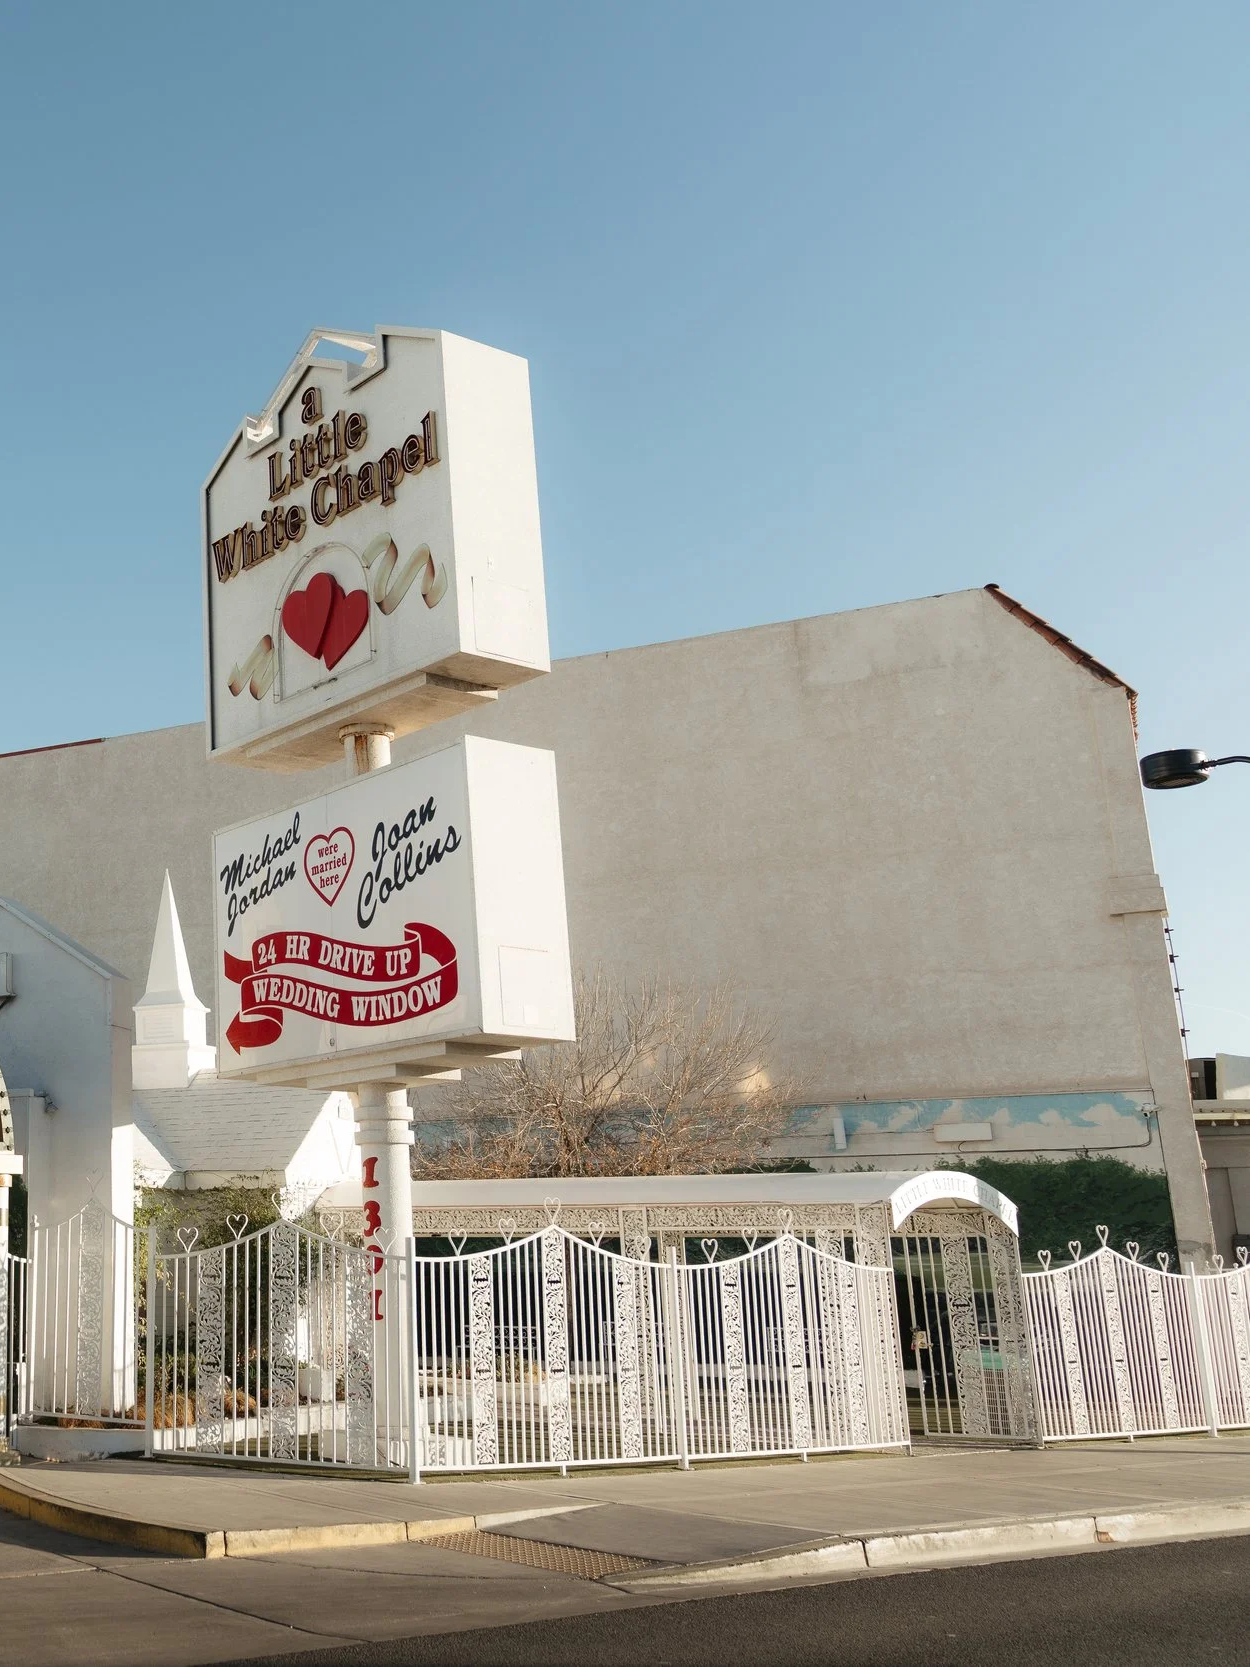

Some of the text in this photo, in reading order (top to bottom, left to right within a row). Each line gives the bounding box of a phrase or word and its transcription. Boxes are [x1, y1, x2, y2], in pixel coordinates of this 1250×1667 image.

[301, 385, 322, 425] a
[267, 409, 367, 502] Little
[211, 410, 440, 584] White Chapel
[220, 811, 301, 895] Michael
[311, 853, 347, 877] married
[317, 842, 339, 859] were
[372, 796, 437, 882] Joan
[227, 860, 297, 937] Jordan
[319, 872, 340, 889] here
[357, 825, 461, 929] Collins
[257, 935, 412, 976] 24 HR DRIVE UP
[252, 976, 442, 1022] WEDDING WINDOW
